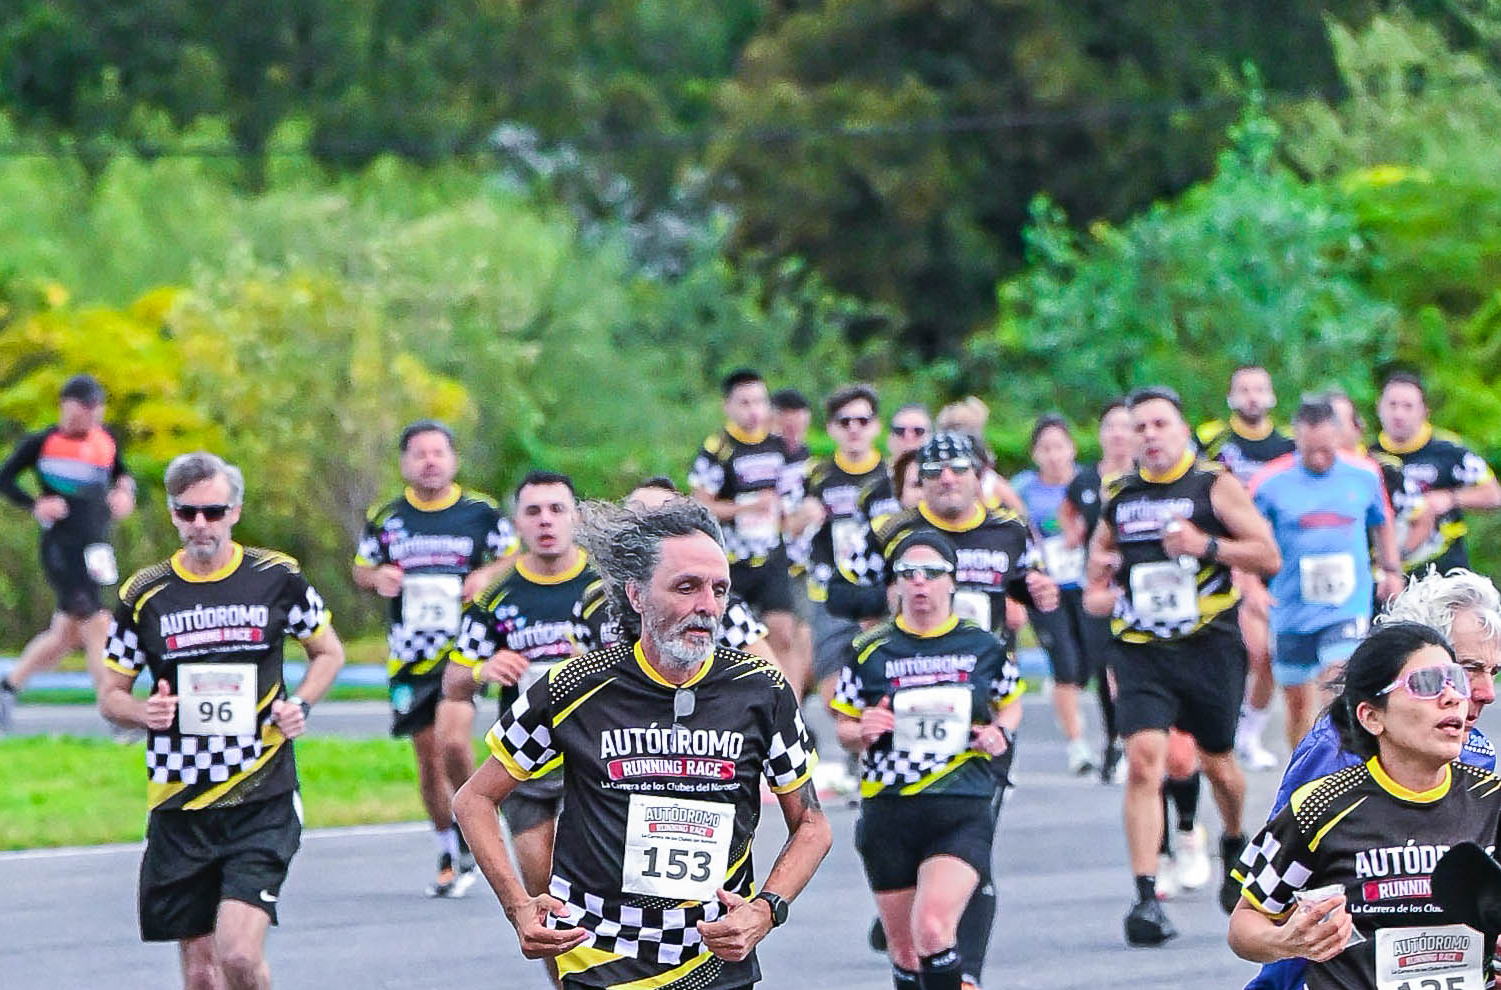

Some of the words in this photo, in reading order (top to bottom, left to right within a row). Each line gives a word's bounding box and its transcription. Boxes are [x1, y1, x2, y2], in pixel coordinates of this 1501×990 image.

[159, 603, 269, 637] AUTÓDROMO
[199, 701, 233, 722] 96
[916, 718, 947, 740] 16
[600, 721, 745, 760] AUTÓDROMO
[621, 758, 683, 777] RUNNING
[686, 760, 722, 778] RACE
[642, 781, 652, 790] de
[653, 781, 665, 791] los
[666, 782, 696, 792] Clubes
[697, 782, 710, 792] del
[644, 803, 720, 828] AUTÓDROMO
[641, 846, 712, 882] 153
[1378, 878, 1432, 899] RUNNIN
[1351, 903, 1362, 913] La
[1362, 904, 1395, 913] Carrera
[1397, 903, 1408, 913] de
[1409, 903, 1422, 913] los
[1393, 932, 1470, 957] AUTÓDROMO
